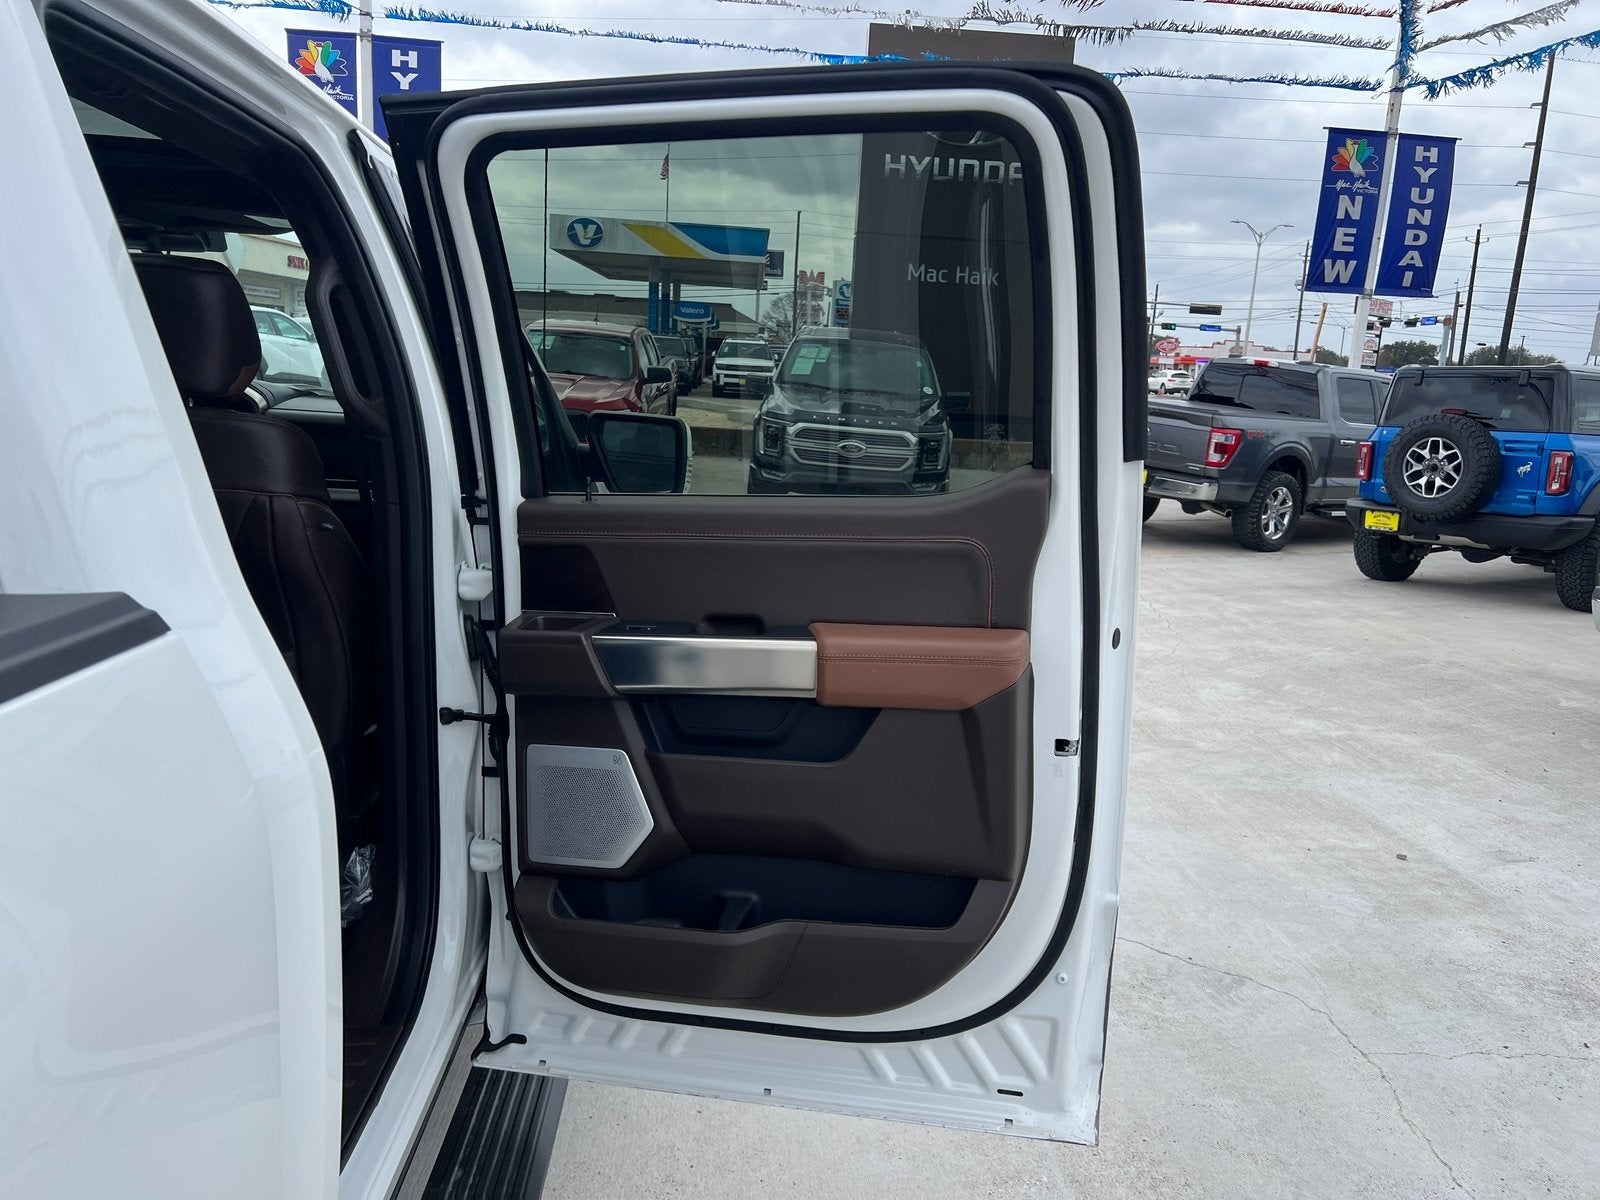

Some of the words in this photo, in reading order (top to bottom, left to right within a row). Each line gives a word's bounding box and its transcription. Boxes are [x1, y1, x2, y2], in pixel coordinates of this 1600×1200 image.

[1397, 145, 1439, 288] HYUNDAI
[1323, 194, 1364, 285] NEW
[907, 263, 948, 283] Mac
[955, 265, 999, 286] Haik
[680, 305, 706, 315] Valero
[812, 414, 899, 426] LIMITED
